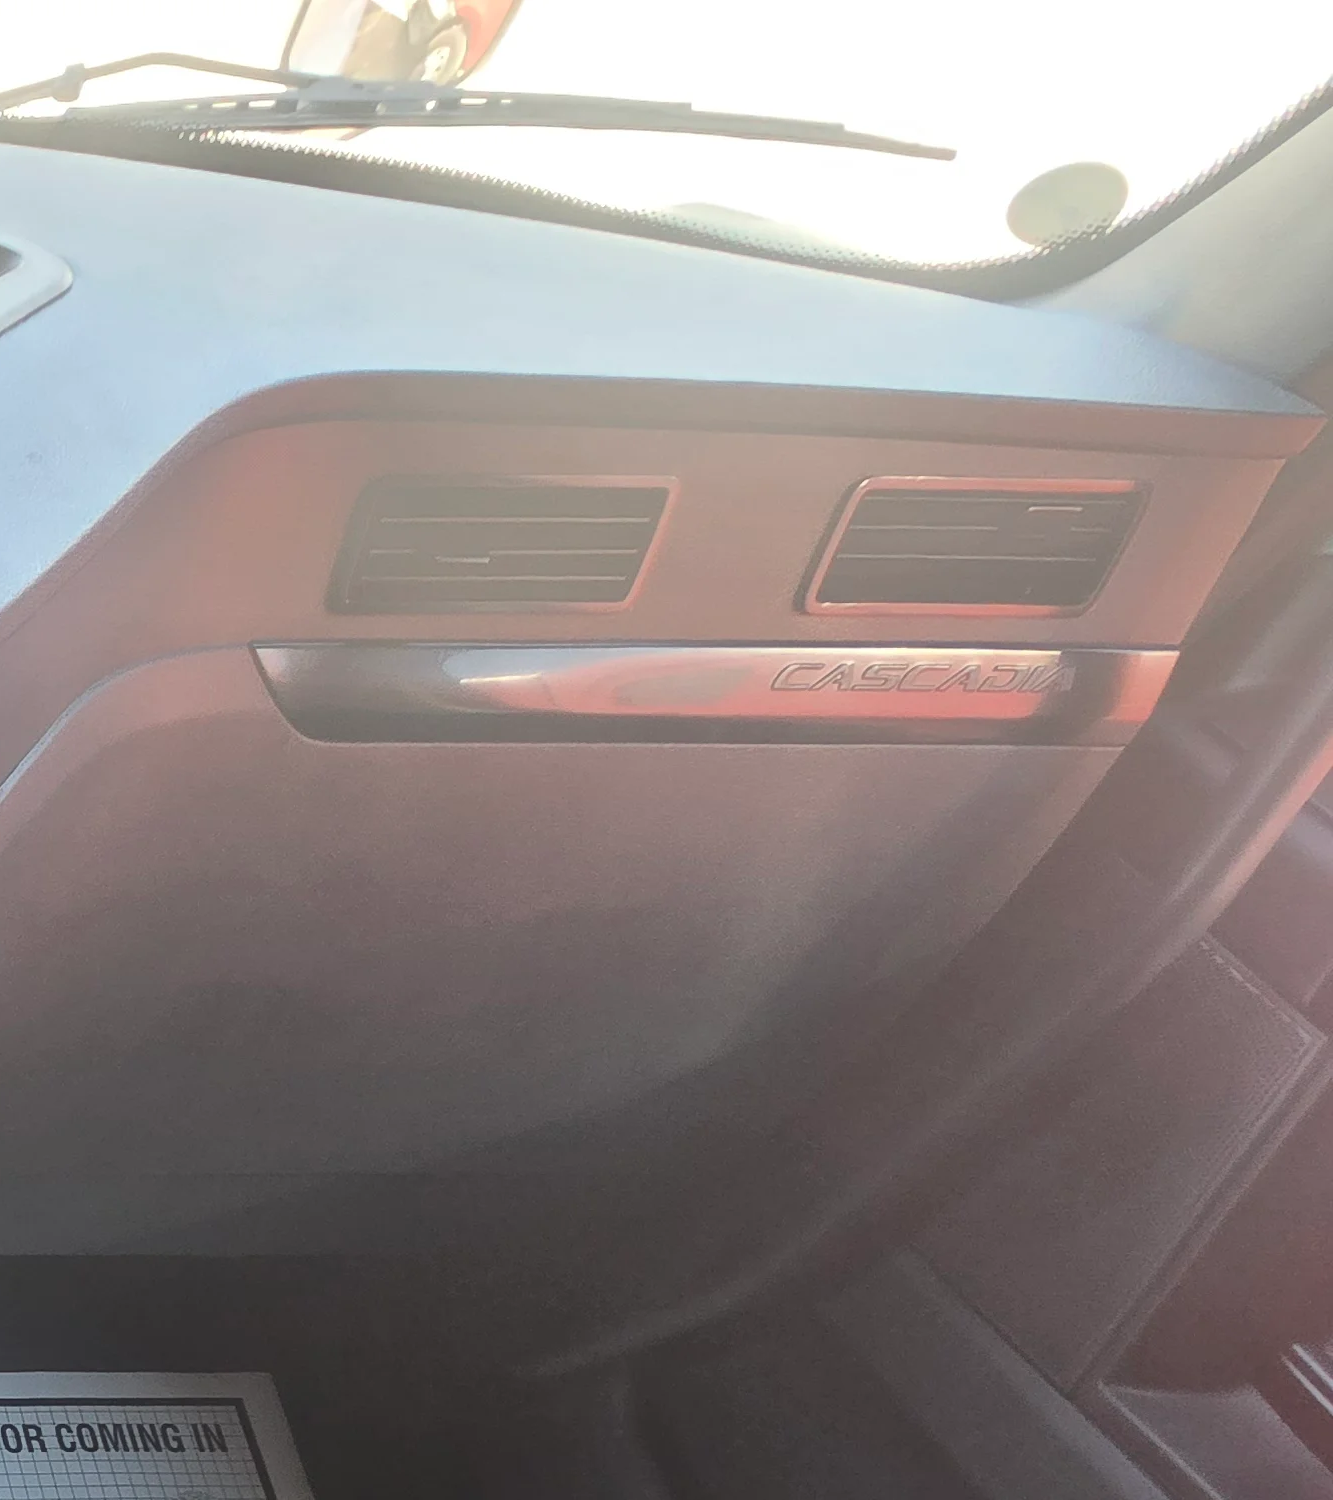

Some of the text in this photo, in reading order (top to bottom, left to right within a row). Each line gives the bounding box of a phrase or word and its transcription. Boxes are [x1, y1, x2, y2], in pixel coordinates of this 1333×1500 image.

[770, 660, 1076, 693] CASCADIA
[55, 1423, 185, 1453] COMING
[190, 1423, 229, 1453] IN
